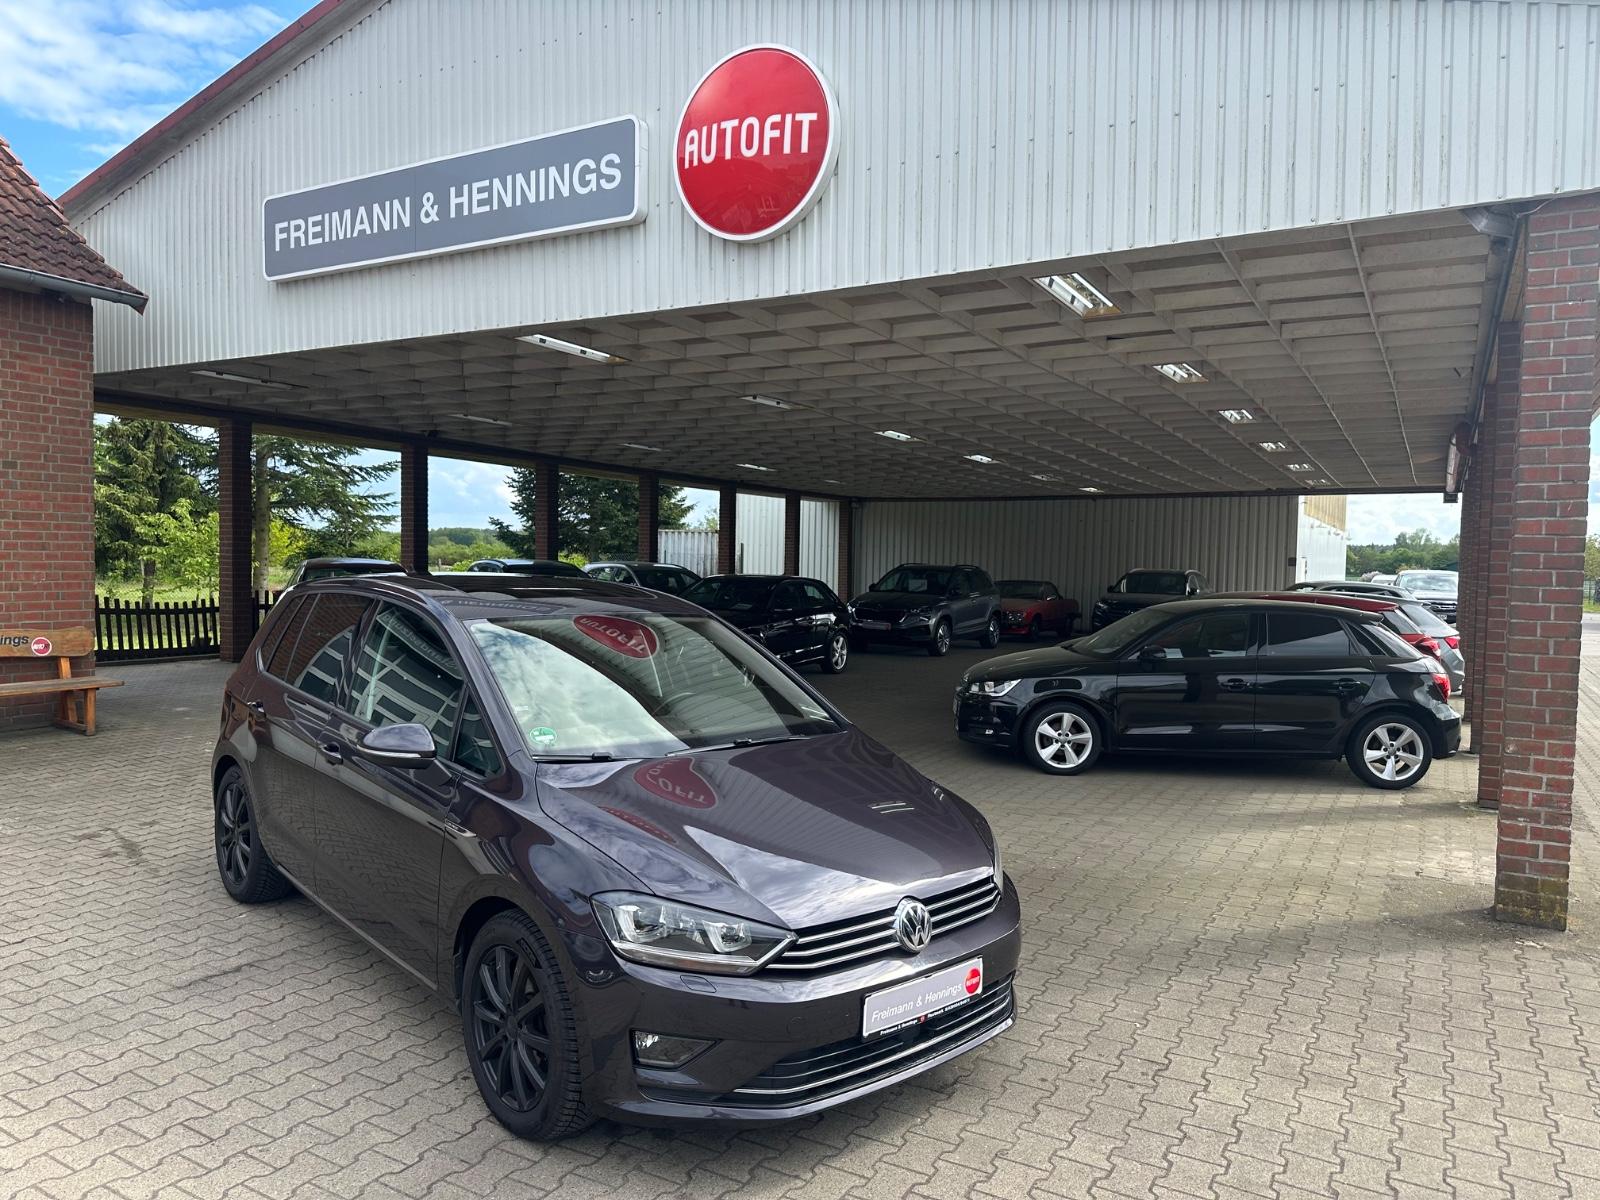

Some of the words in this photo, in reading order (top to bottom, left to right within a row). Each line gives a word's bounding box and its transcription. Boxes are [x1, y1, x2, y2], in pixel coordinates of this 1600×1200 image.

[684, 112, 818, 169] AUTOFIT
[274, 196, 411, 252] FREIMANN
[420, 191, 440, 225] &
[449, 153, 622, 219] HENNINGS
[871, 1000, 914, 1023] Freimann
[916, 994, 923, 1007] &
[925, 983, 962, 1004] Hennings
